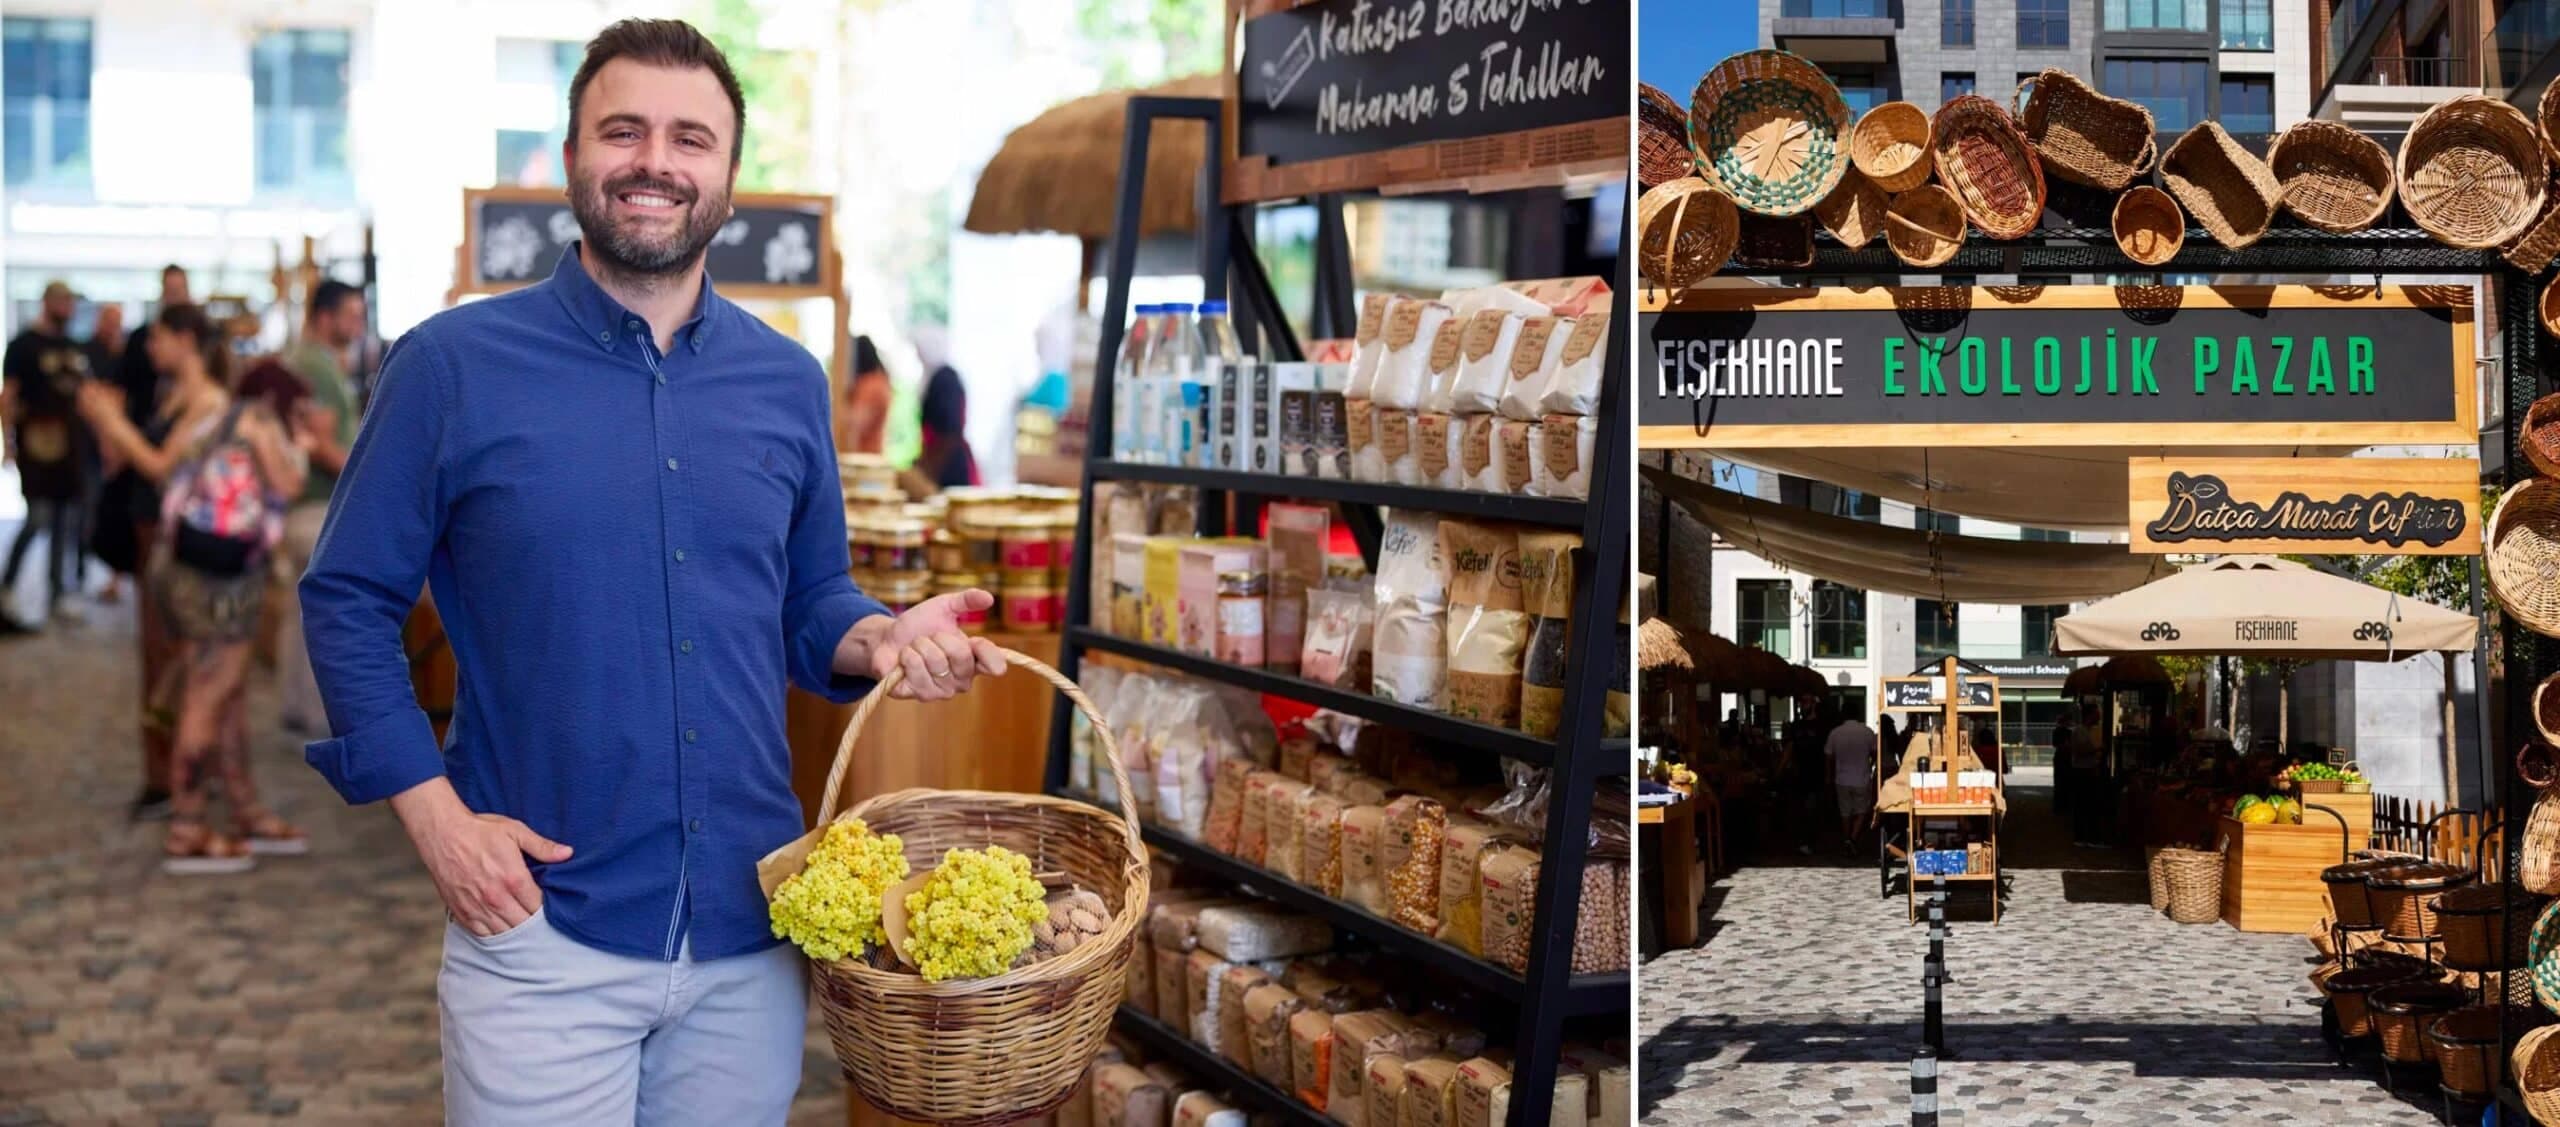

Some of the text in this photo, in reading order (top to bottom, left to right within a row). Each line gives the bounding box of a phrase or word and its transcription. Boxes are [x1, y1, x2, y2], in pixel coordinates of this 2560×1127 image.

[1316, 79, 1439, 136] Makarna
[1883, 328, 2160, 396] EKOLOJİK
[2193, 336, 2376, 395] PAZAR
[2154, 492, 2259, 535] Datça
[2260, 499, 2362, 531] Murat
[1984, 664, 2034, 674] Montessori
[2036, 664, 2070, 674] Schools
